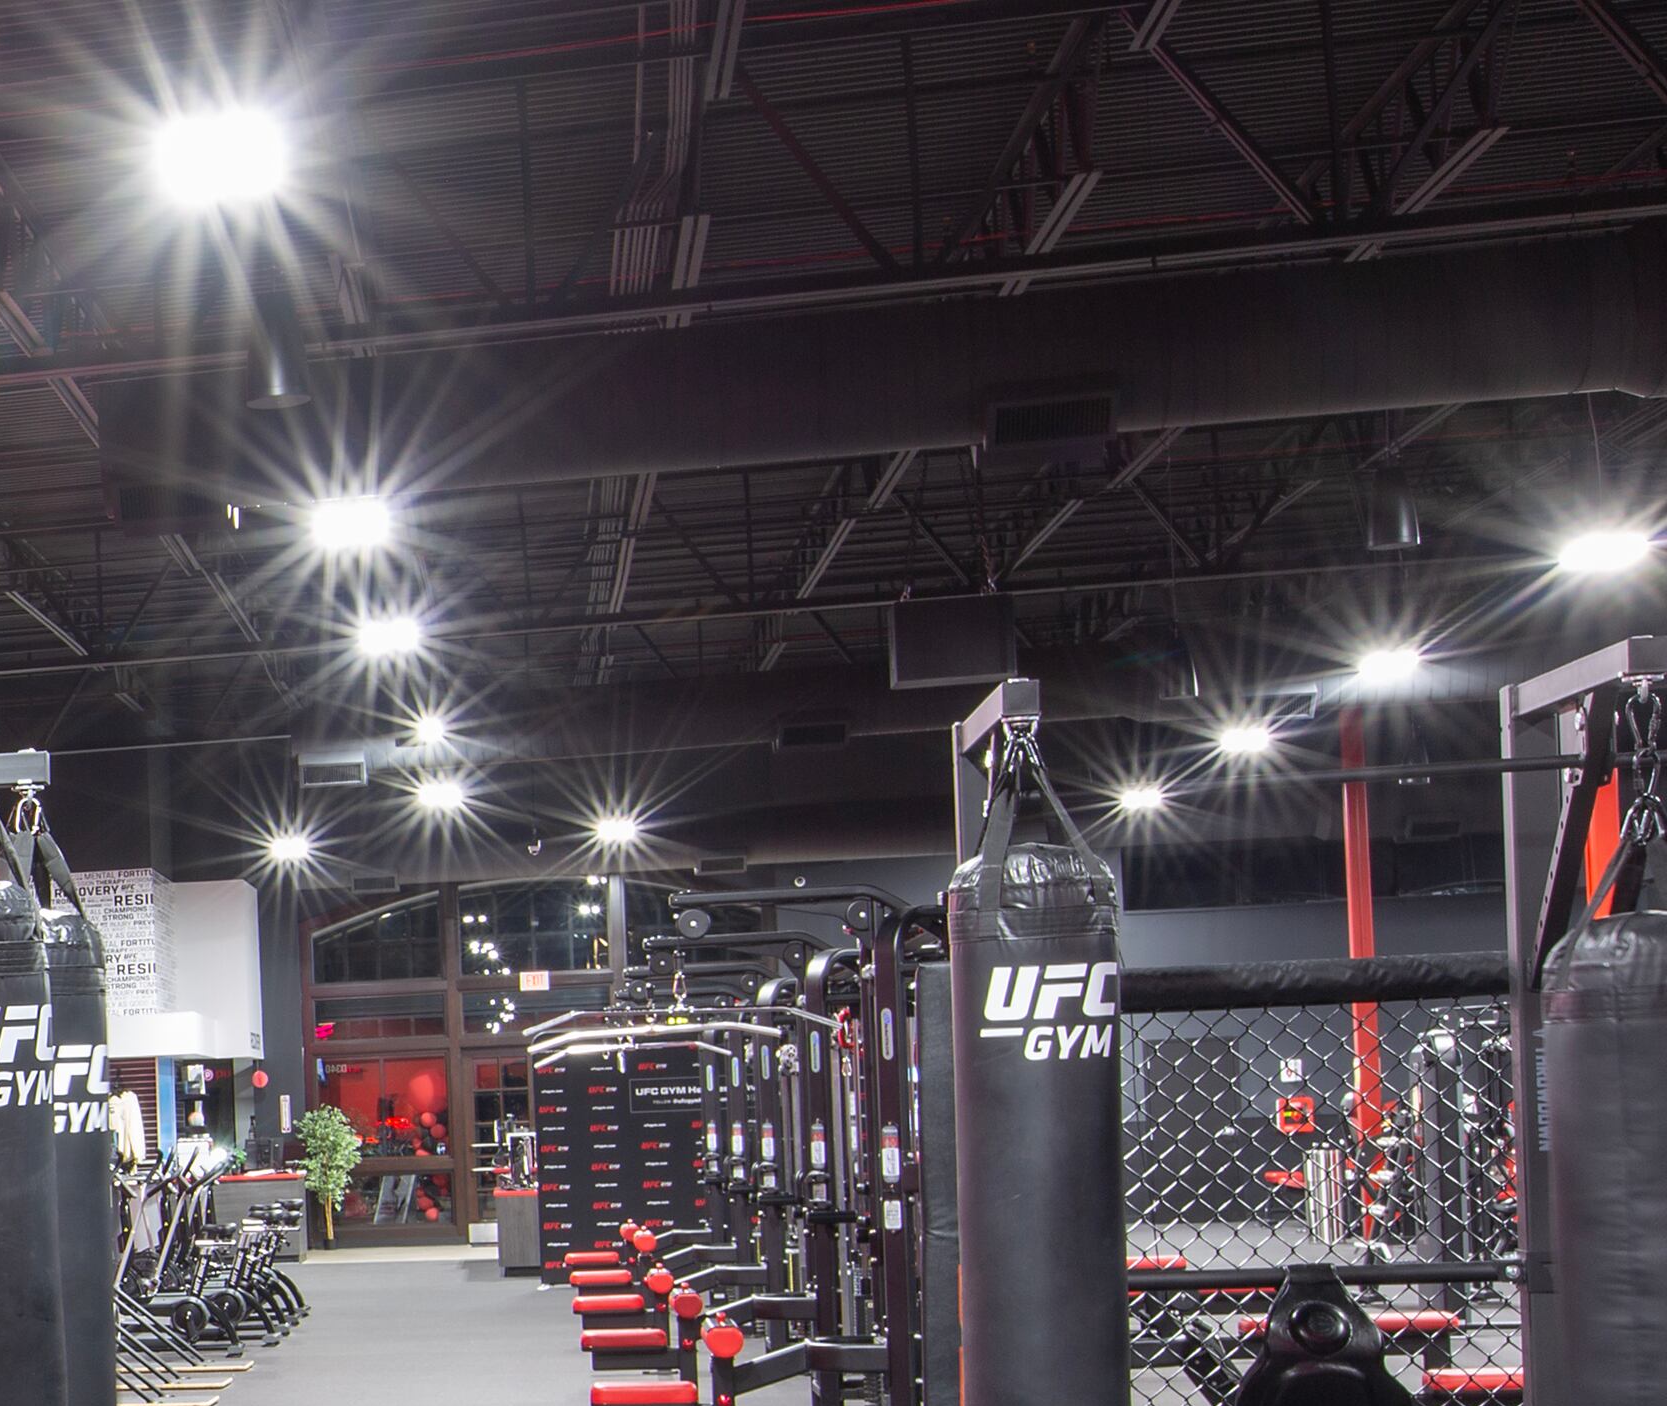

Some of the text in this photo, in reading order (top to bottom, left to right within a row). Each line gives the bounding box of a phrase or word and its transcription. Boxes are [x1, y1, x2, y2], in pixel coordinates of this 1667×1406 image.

[54, 885, 119, 899] ROVERY
[984, 962, 1117, 1021] UFC
[1024, 1024, 1113, 1061] GYM
[53, 1044, 110, 1096] FC
[635, 1086, 659, 1096] UFC
[660, 1085, 686, 1096] GYM
